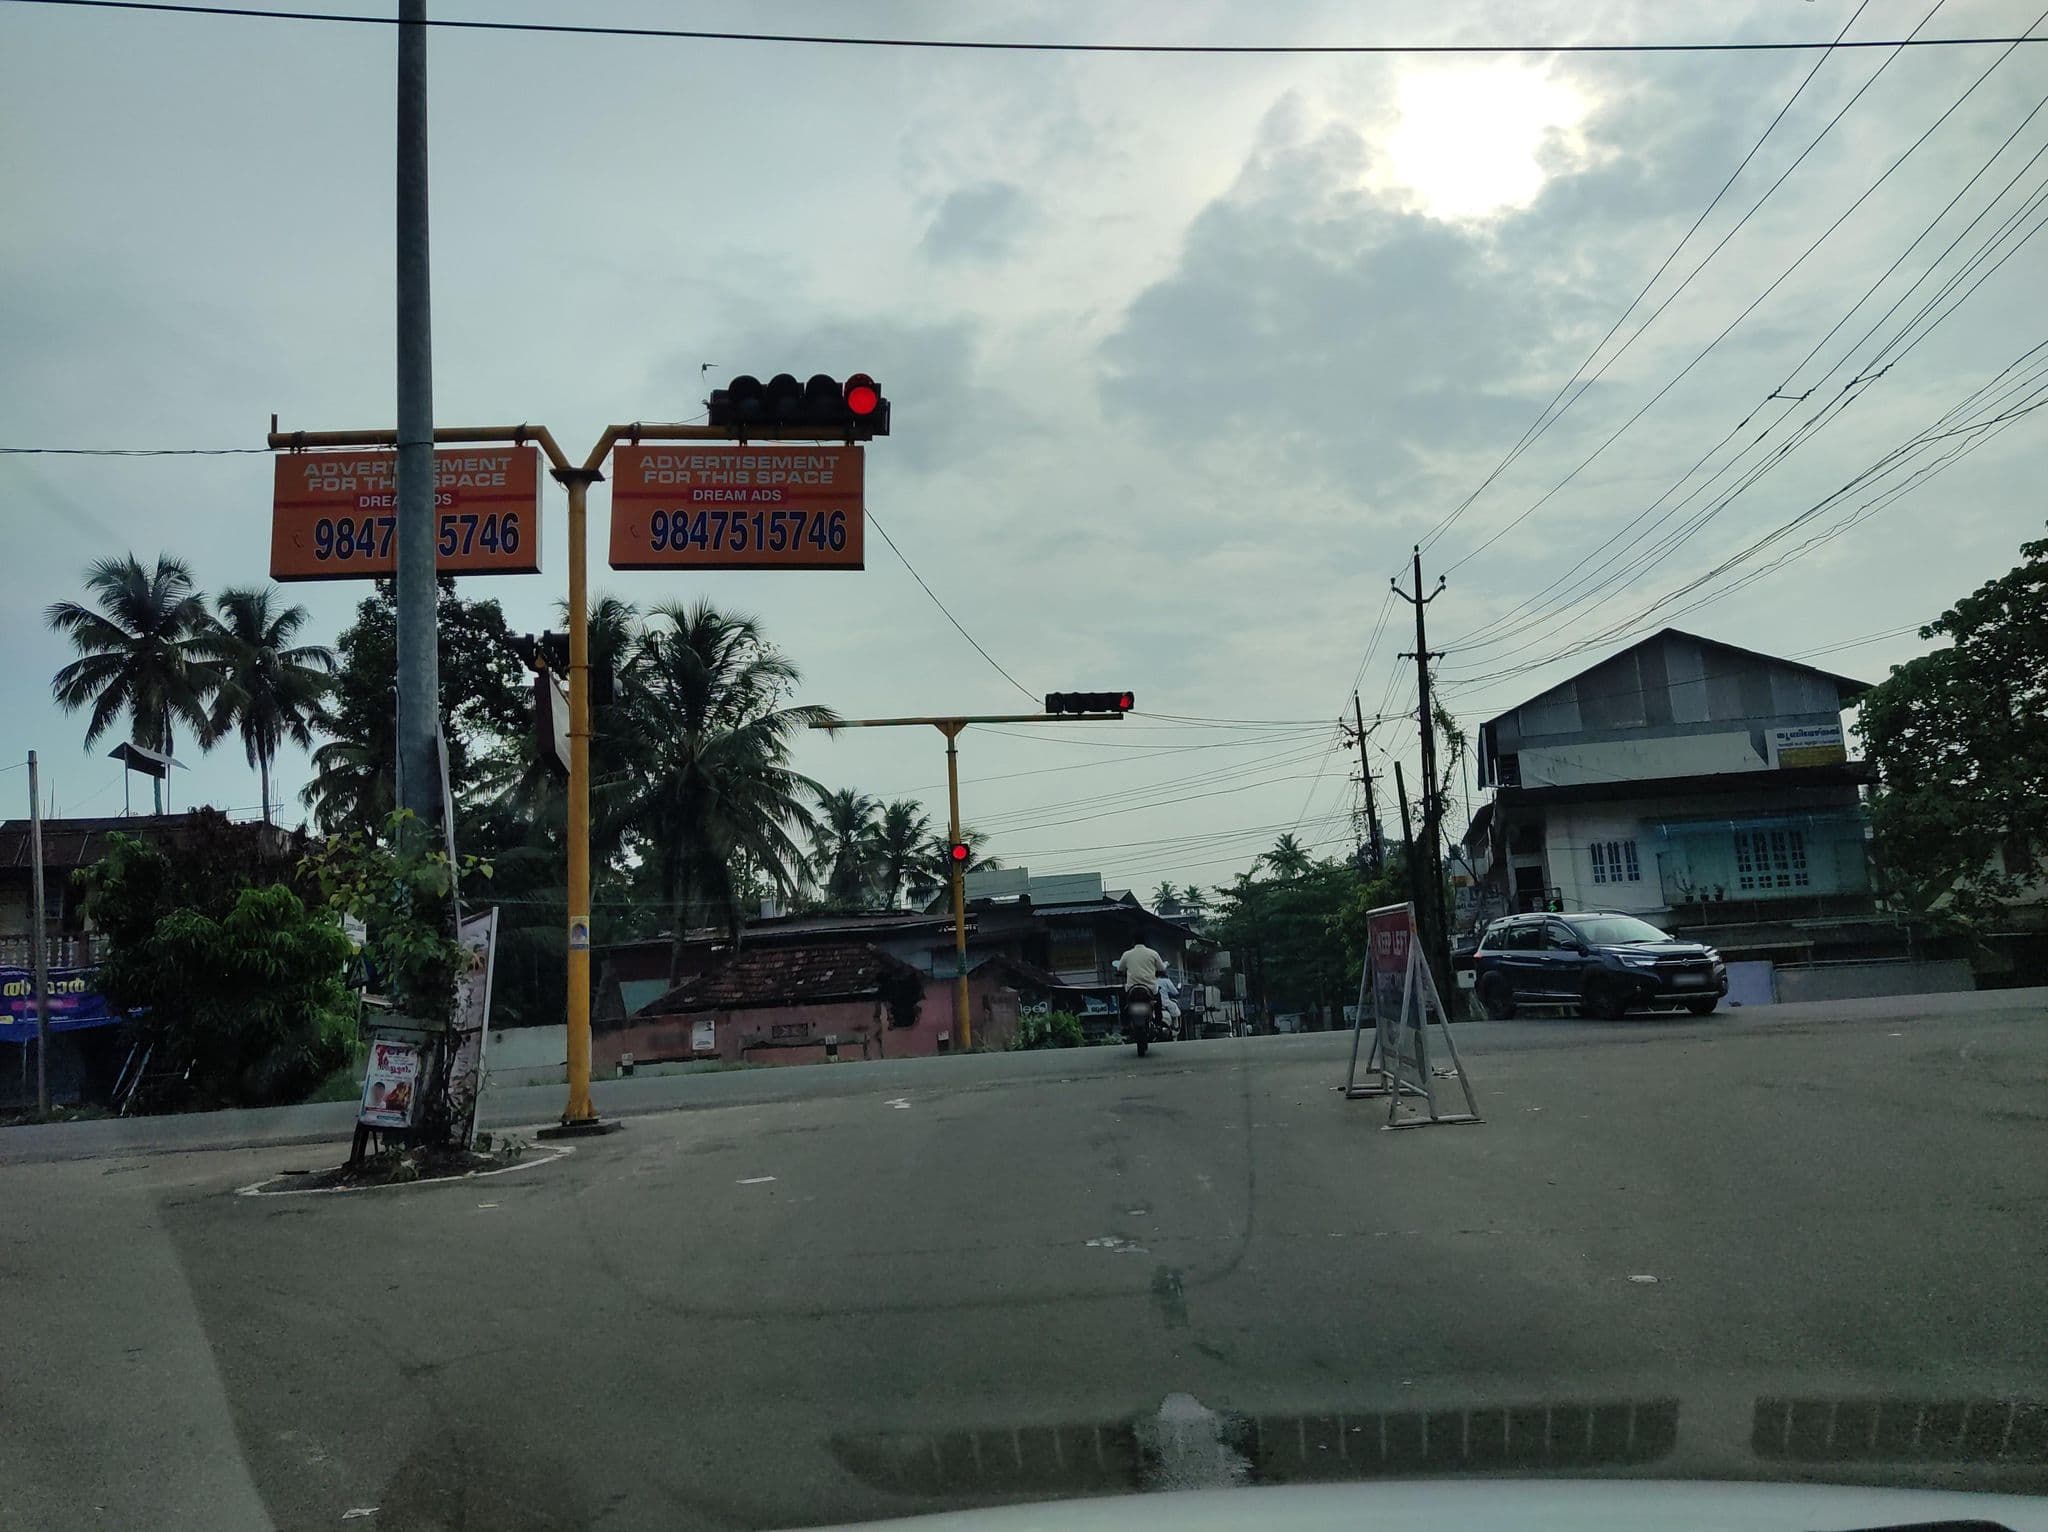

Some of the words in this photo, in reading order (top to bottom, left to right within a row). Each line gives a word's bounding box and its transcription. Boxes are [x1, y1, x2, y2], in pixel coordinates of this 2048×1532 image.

[304, 457, 512, 477] ADVERTEMENT
[640, 455, 840, 469] ADVERTISEMENT
[308, 477, 357, 492] FOR
[364, 475, 397, 491] TH
[644, 470, 691, 484] FOR
[697, 470, 750, 484] THIS
[756, 470, 834, 484] SPACE
[359, 494, 399, 508] DREA
[433, 493, 453, 506] DS
[693, 489, 747, 501] DREAM
[751, 489, 783, 501] ADS
[314, 512, 520, 560] 98475746
[650, 509, 847, 552] 9847515746
